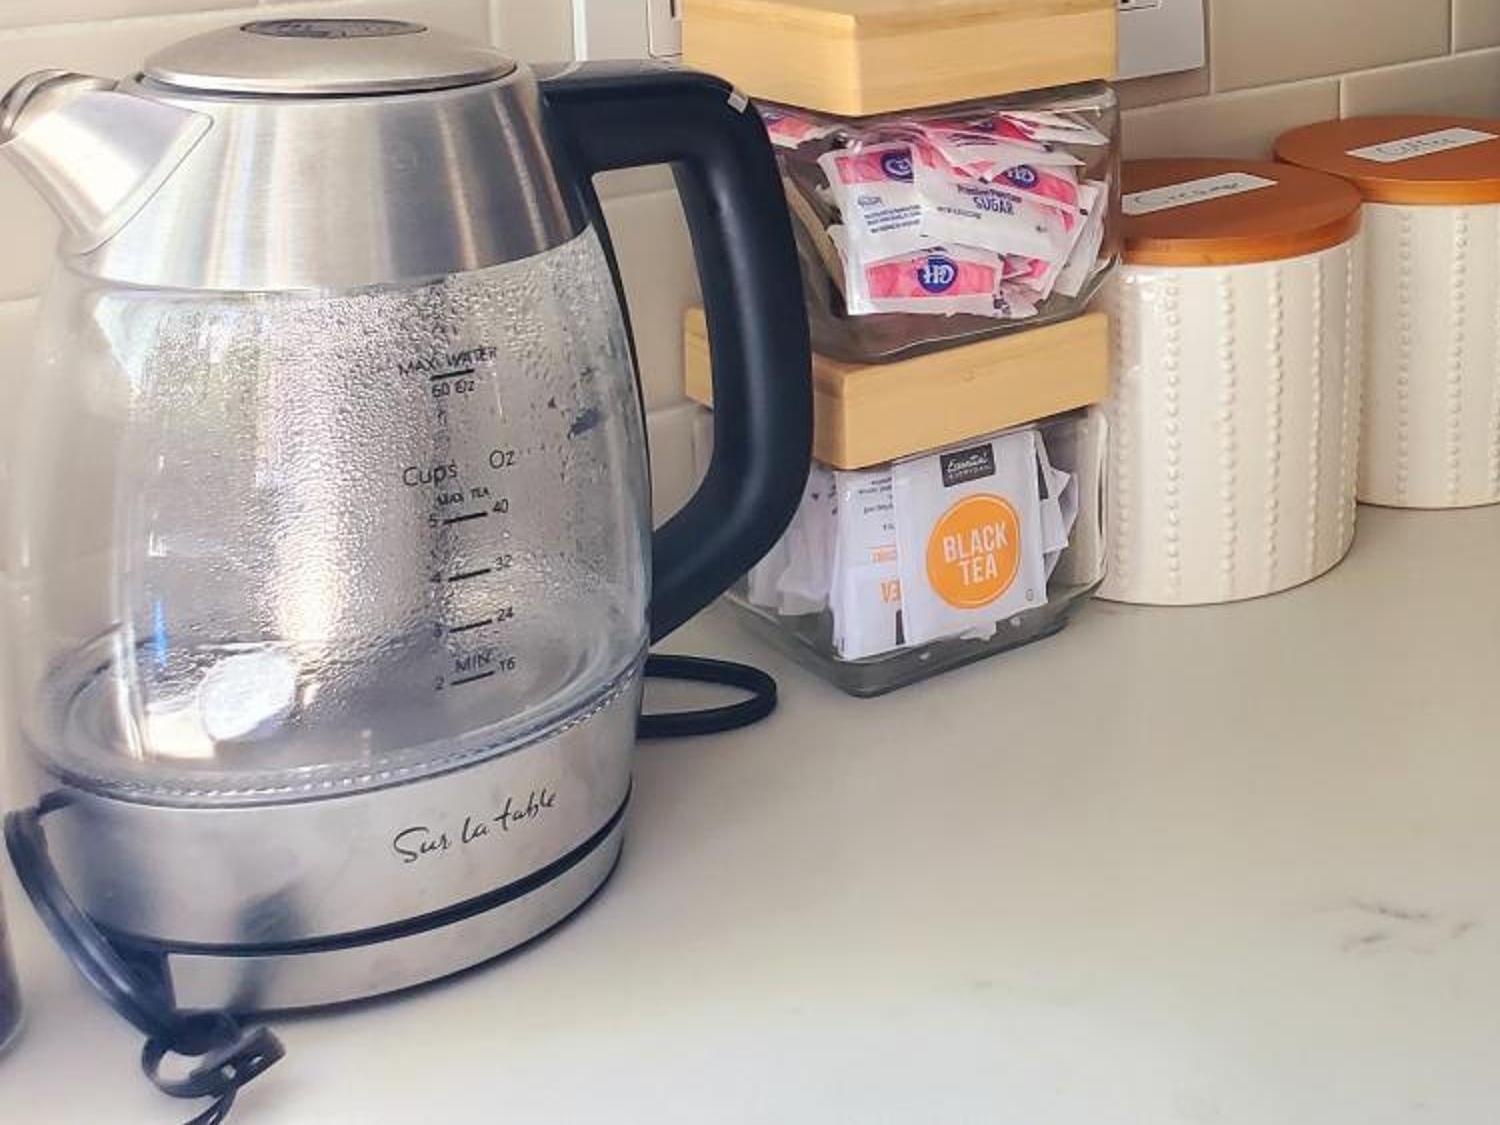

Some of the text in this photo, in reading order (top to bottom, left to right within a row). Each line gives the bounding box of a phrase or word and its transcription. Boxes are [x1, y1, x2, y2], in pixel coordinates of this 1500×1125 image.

[402, 459, 457, 488] Cups
[943, 522, 1009, 565] BLACK
[959, 553, 998, 587] TEA
[454, 652, 492, 672] MIN
